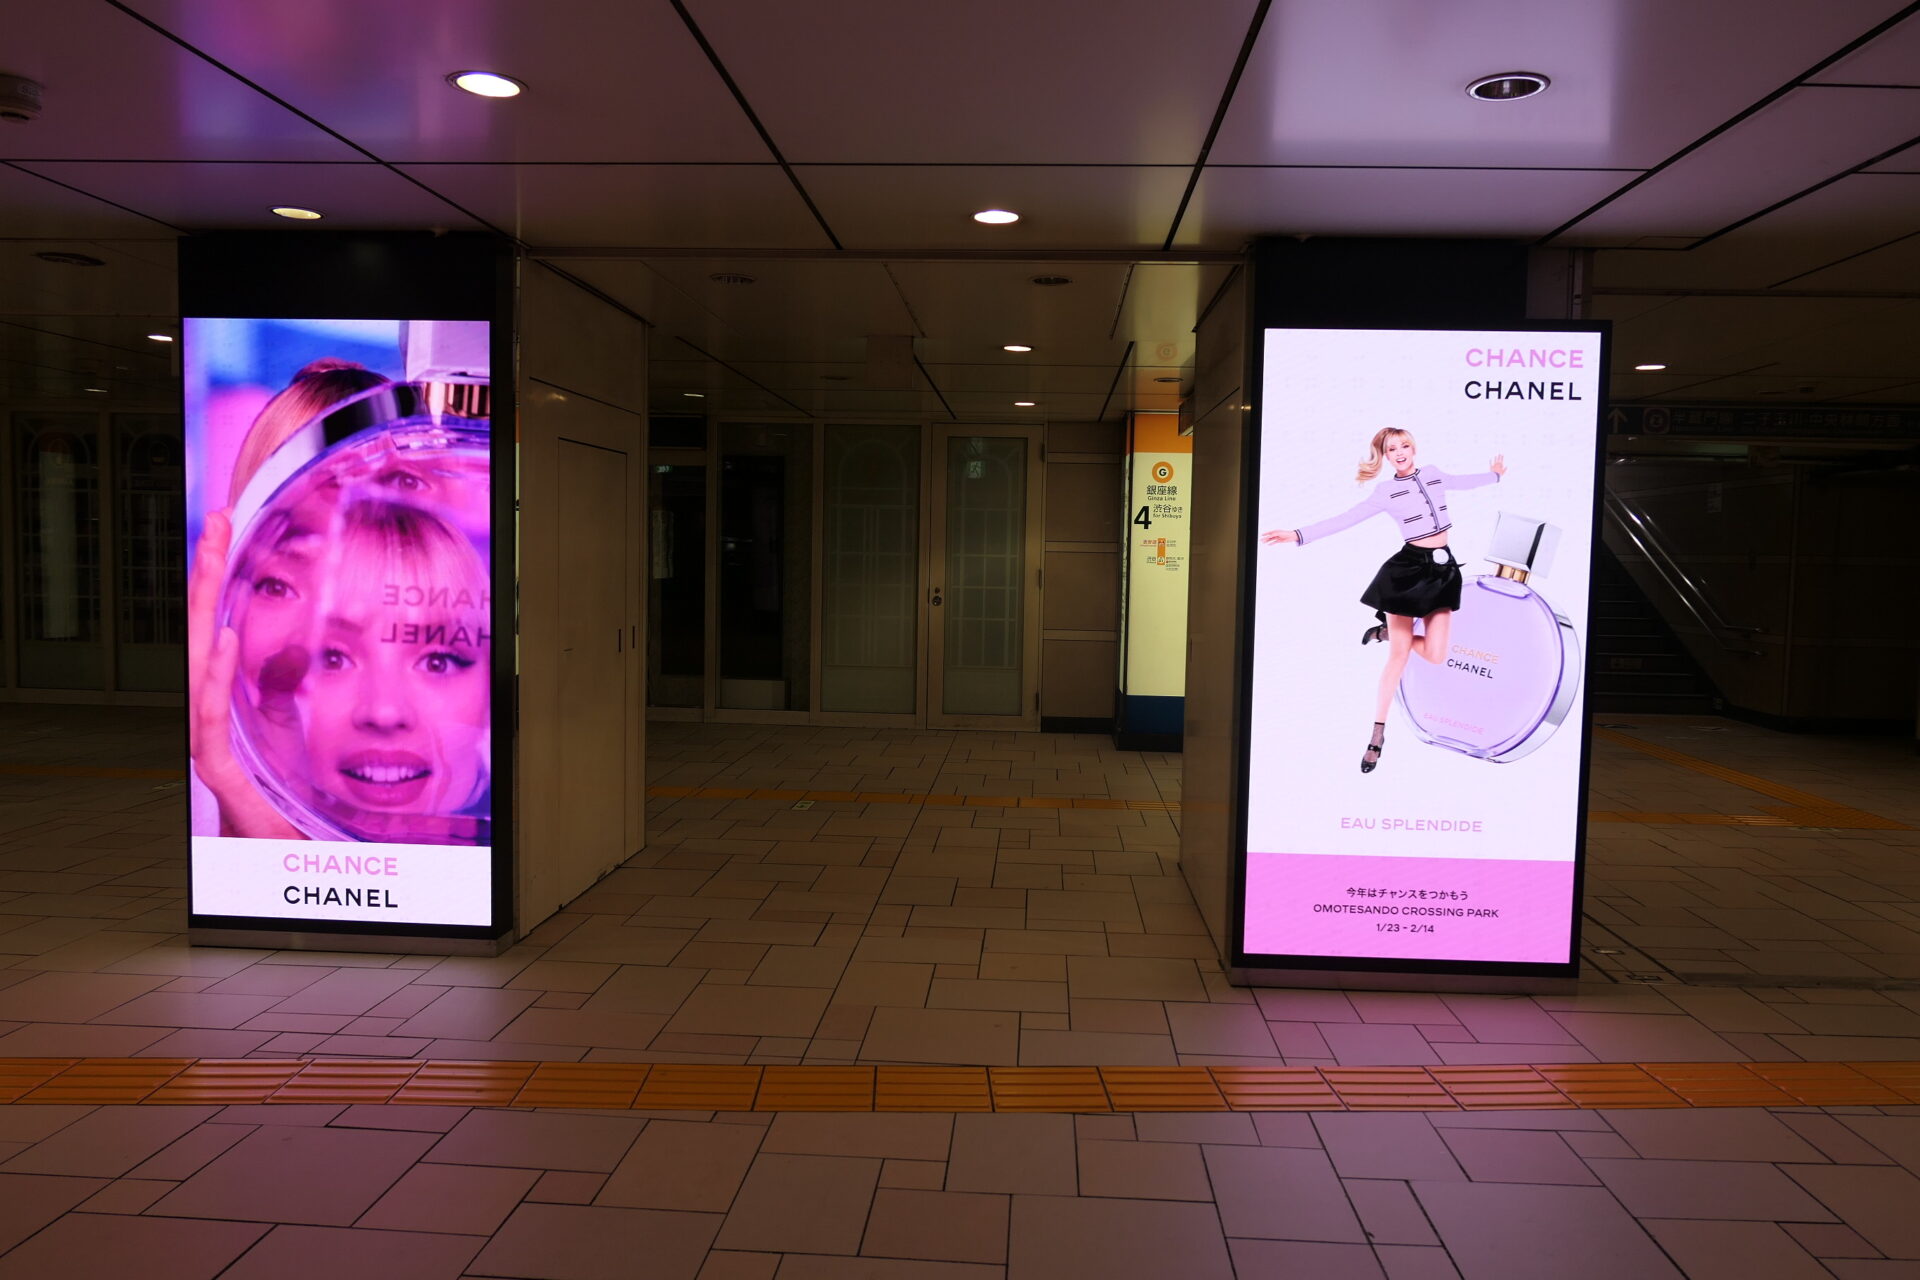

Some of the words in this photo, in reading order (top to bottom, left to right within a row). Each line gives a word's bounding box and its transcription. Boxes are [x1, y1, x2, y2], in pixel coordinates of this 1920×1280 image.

[1465, 348, 1584, 369] CHANCE
[1464, 380, 1582, 401] CHANEL
[1158, 468, 1168, 477] G
[1146, 485, 1178, 496] 銀座線
[1133, 505, 1152, 530] 4
[1451, 644, 1500, 664] CHANCE
[1446, 658, 1494, 679] CHANEL
[1340, 817, 1376, 829] EAU
[1381, 818, 1483, 833] SPLENDIDE
[283, 853, 399, 876] CHANCE
[283, 885, 399, 908] CHANEL
[1346, 887, 1469, 901] 今年はチャンスをつかもう
[1313, 903, 1399, 915] OMOTESANDO
[1401, 906, 1464, 917] CROSSING
[1466, 908, 1499, 918] PARK
[1376, 923, 1400, 932] 1/23
[1410, 924, 1435, 933] 2/14
